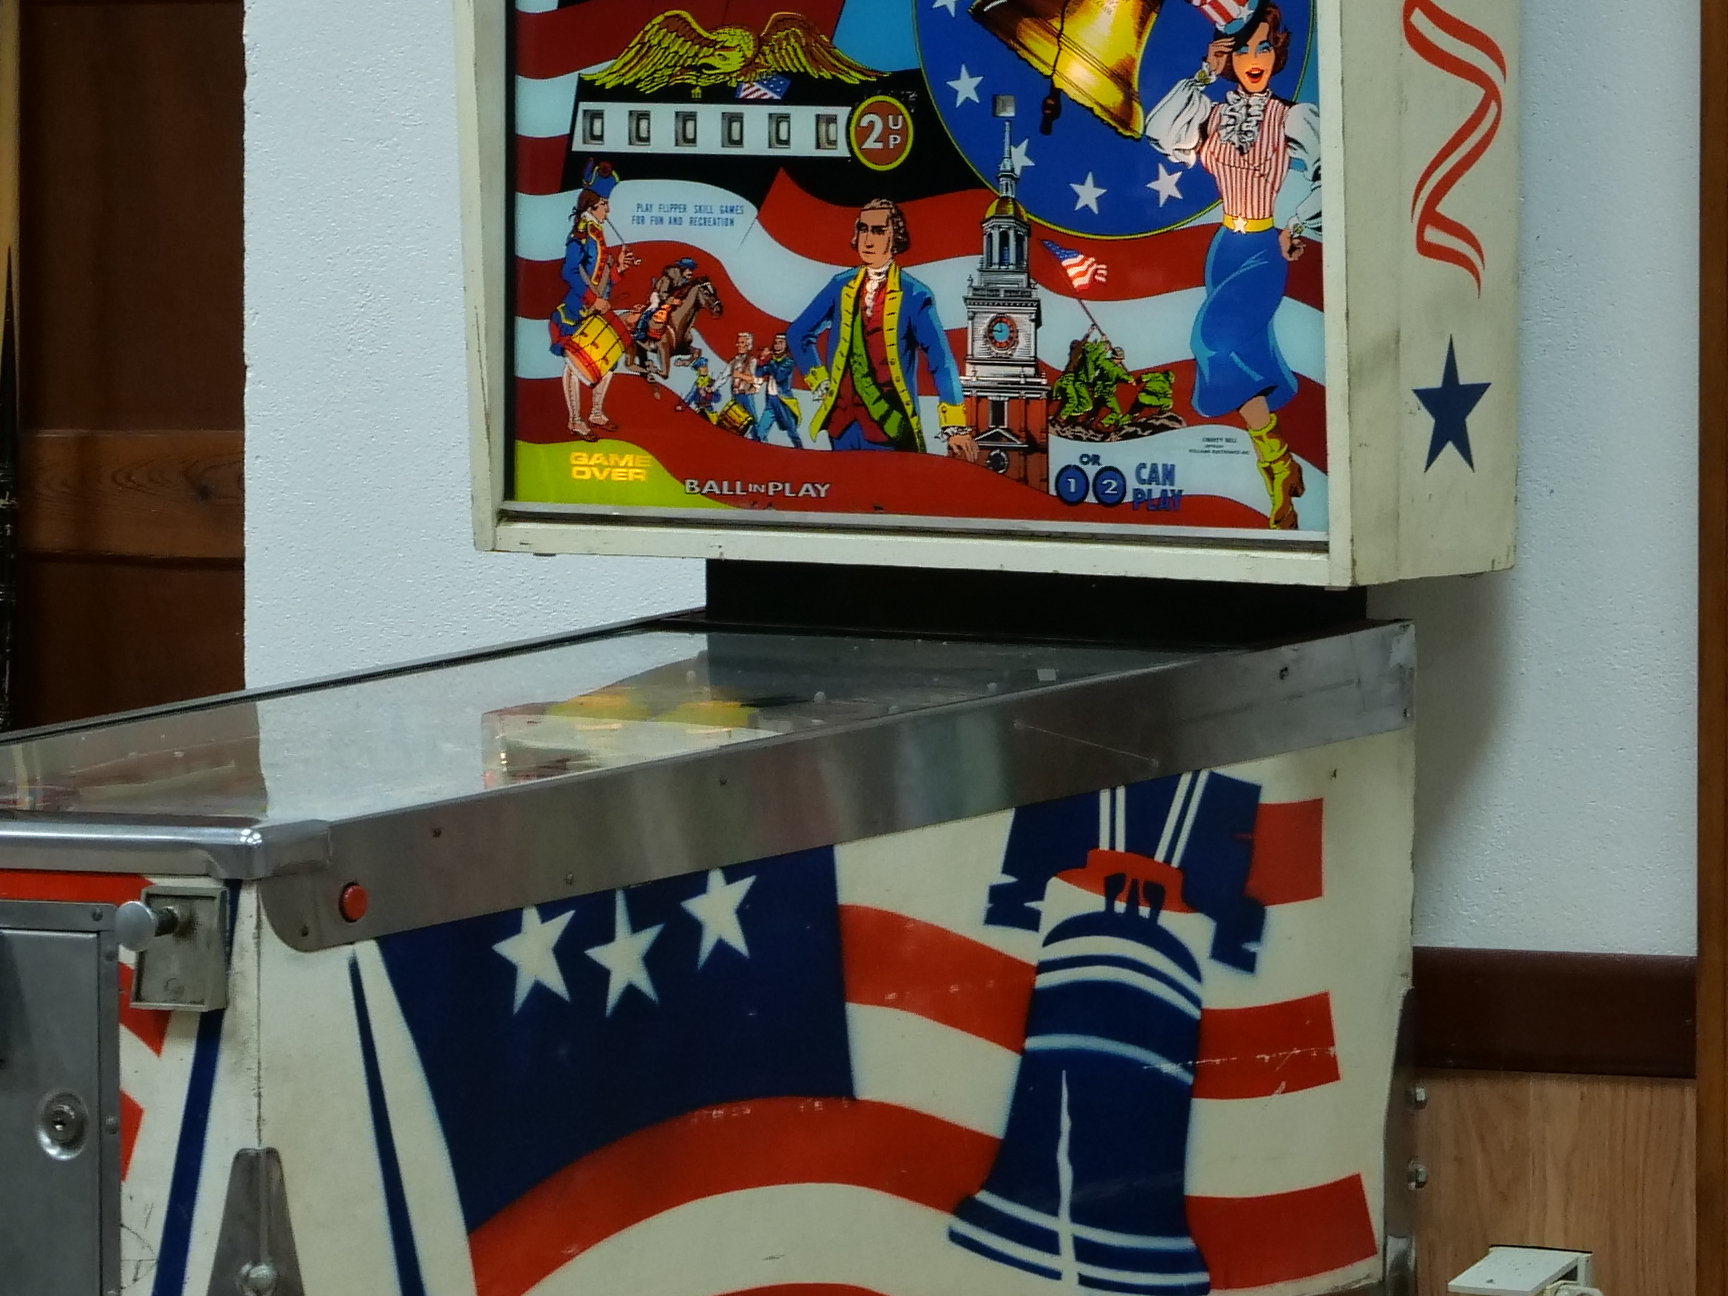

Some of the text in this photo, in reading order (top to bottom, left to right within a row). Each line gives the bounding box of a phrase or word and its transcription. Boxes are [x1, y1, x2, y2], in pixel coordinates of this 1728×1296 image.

[860, 114, 884, 149] 2
[636, 203, 744, 215] PLAY FLIPPER SKILL GAMES
[632, 216, 734, 227] FOR FUN AND RECREATION
[569, 451, 652, 467] GAME
[1079, 452, 1102, 465] OR
[569, 467, 648, 482] OVER
[1135, 462, 1177, 487] CAN
[684, 479, 830, 499] BALL IN PLAY
[1065, 476, 1117, 495] 1 2
[1132, 487, 1183, 512] PLAY
